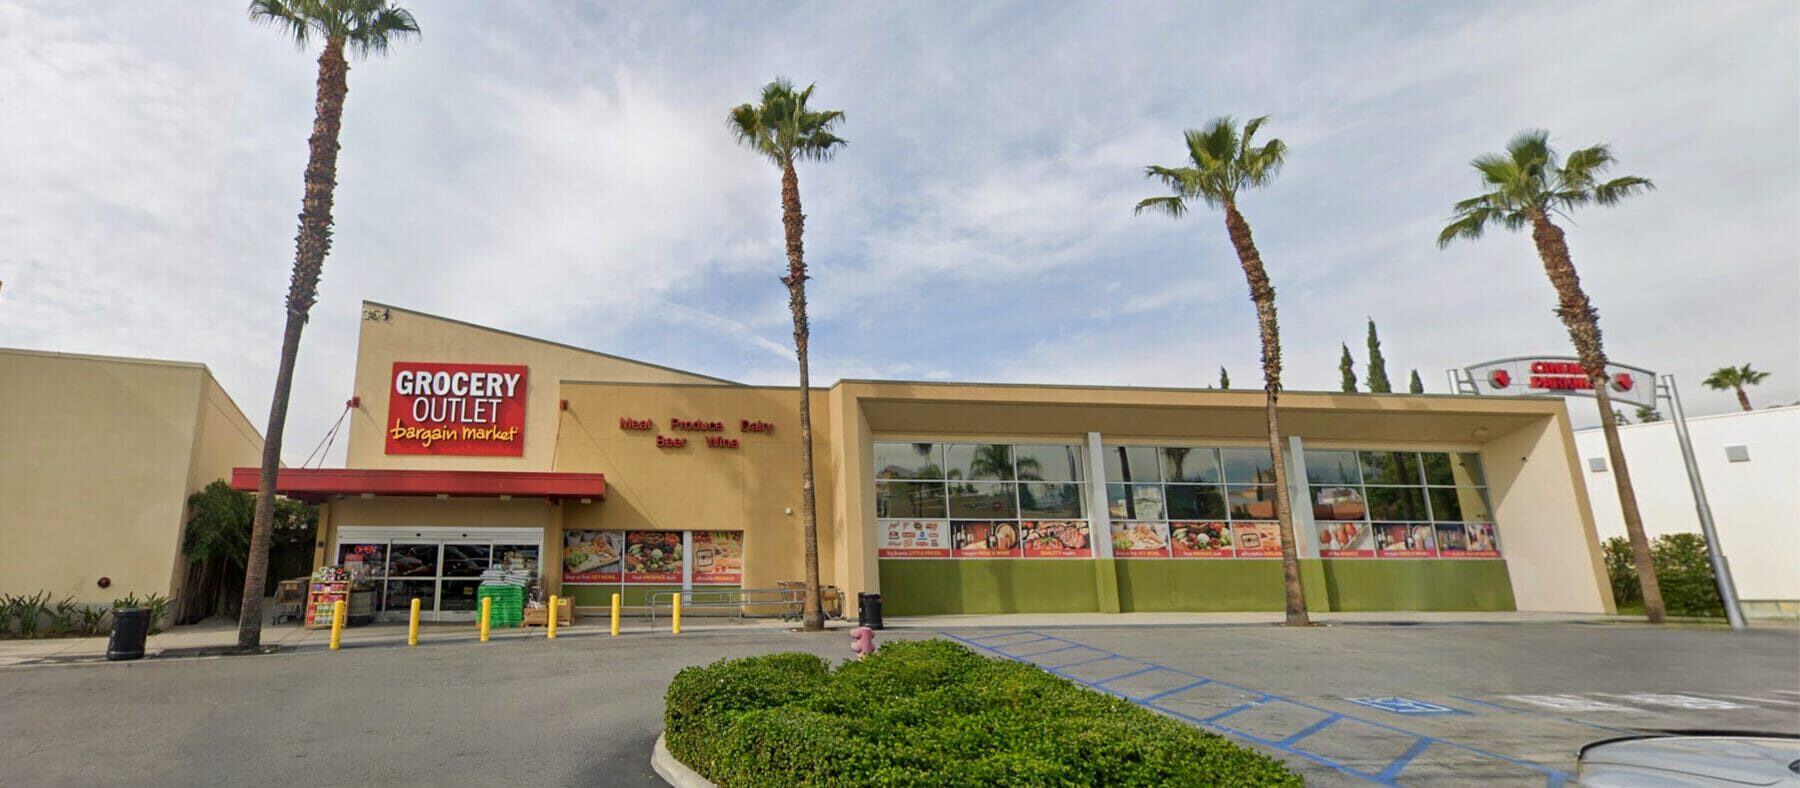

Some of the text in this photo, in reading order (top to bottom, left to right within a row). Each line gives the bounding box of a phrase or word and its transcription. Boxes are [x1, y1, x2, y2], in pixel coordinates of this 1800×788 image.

[1530, 361, 1584, 374] CINEM
[395, 370, 521, 397] GROCERY
[412, 397, 502, 423] OUTLET
[390, 418, 518, 447] bargain market
[619, 417, 774, 435] Meat Produce Dairy
[656, 435, 739, 448] Beer Wine
[354, 545, 377, 554] OPEN
